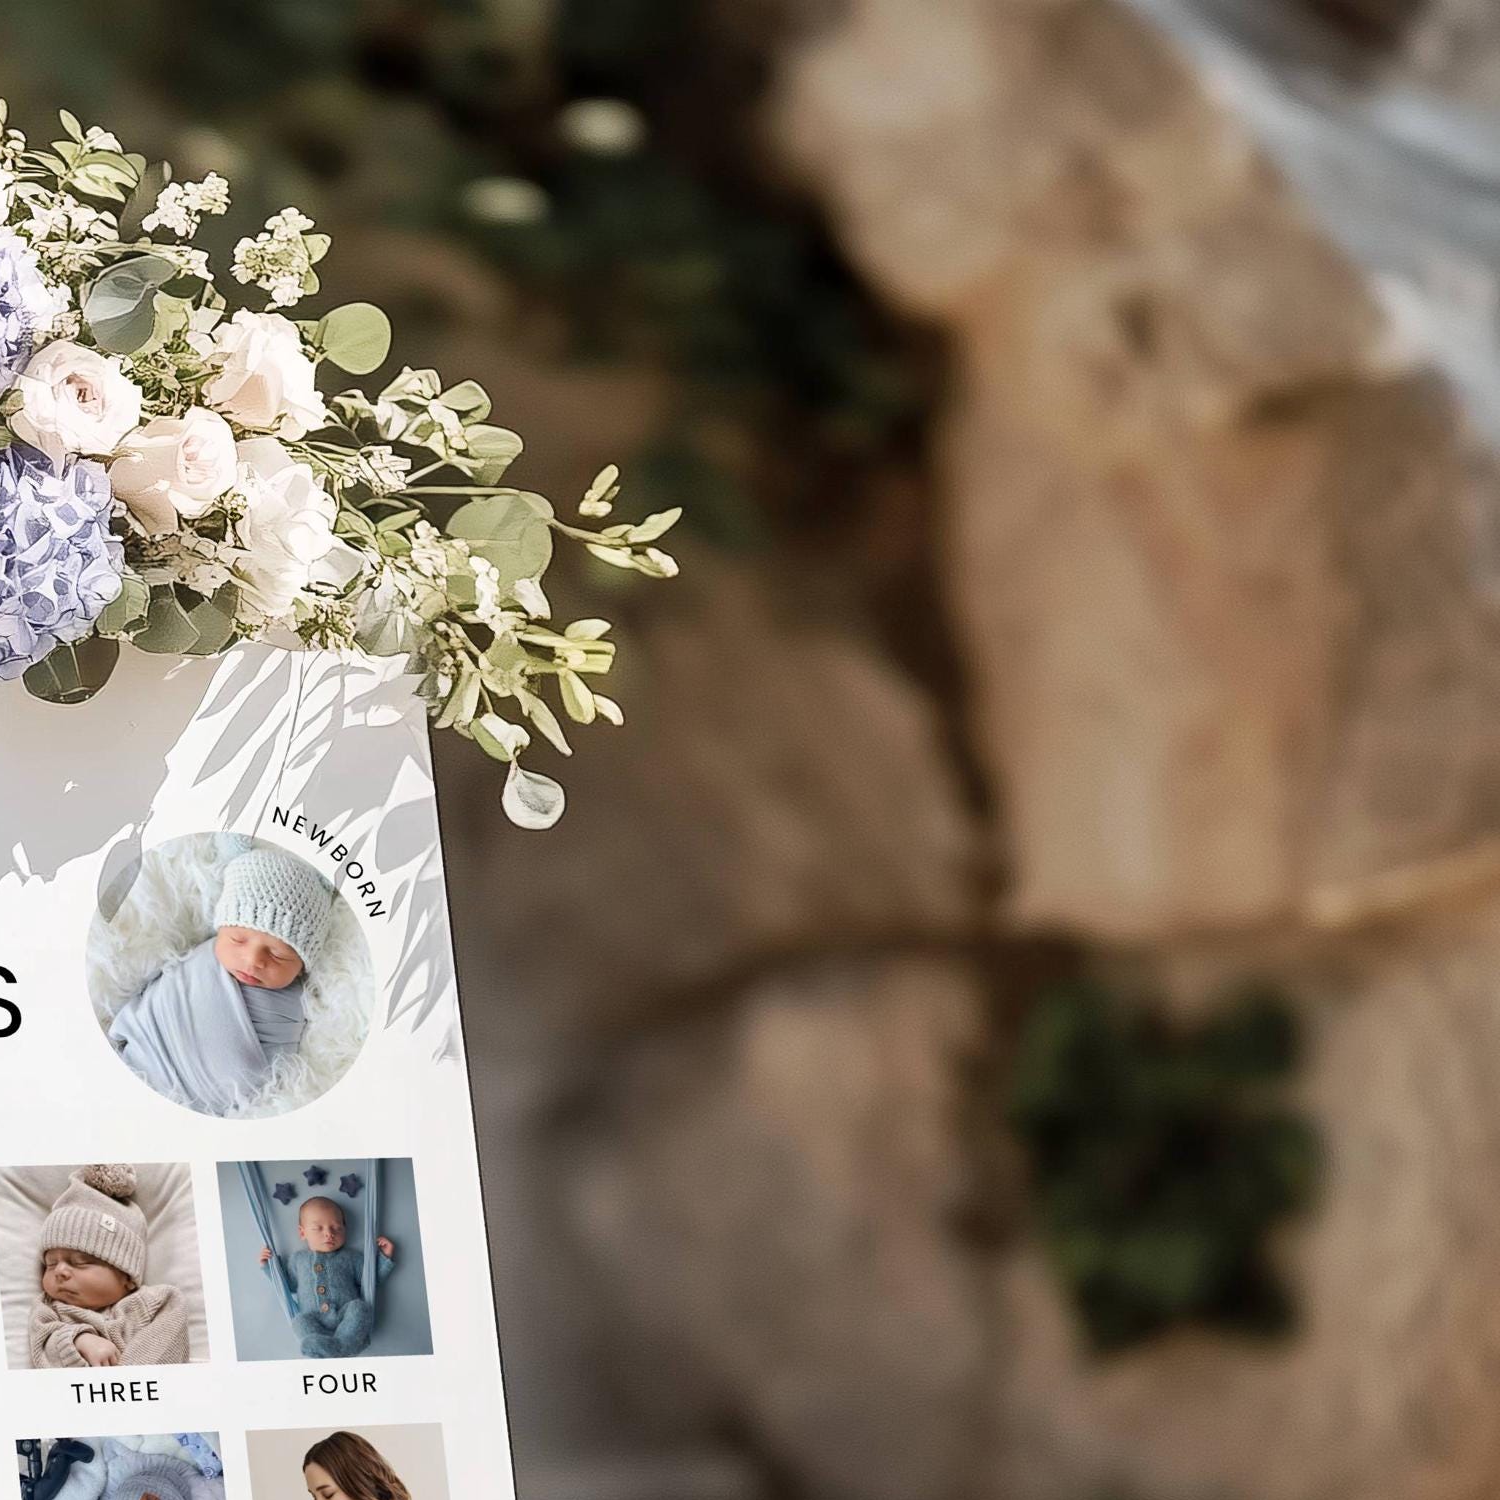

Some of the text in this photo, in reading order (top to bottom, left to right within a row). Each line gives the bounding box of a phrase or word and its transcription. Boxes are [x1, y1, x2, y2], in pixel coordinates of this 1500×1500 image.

[272, 806, 386, 920] NEWBORN
[70, 1380, 159, 1404] THREE
[302, 1372, 377, 1395] FOUR
